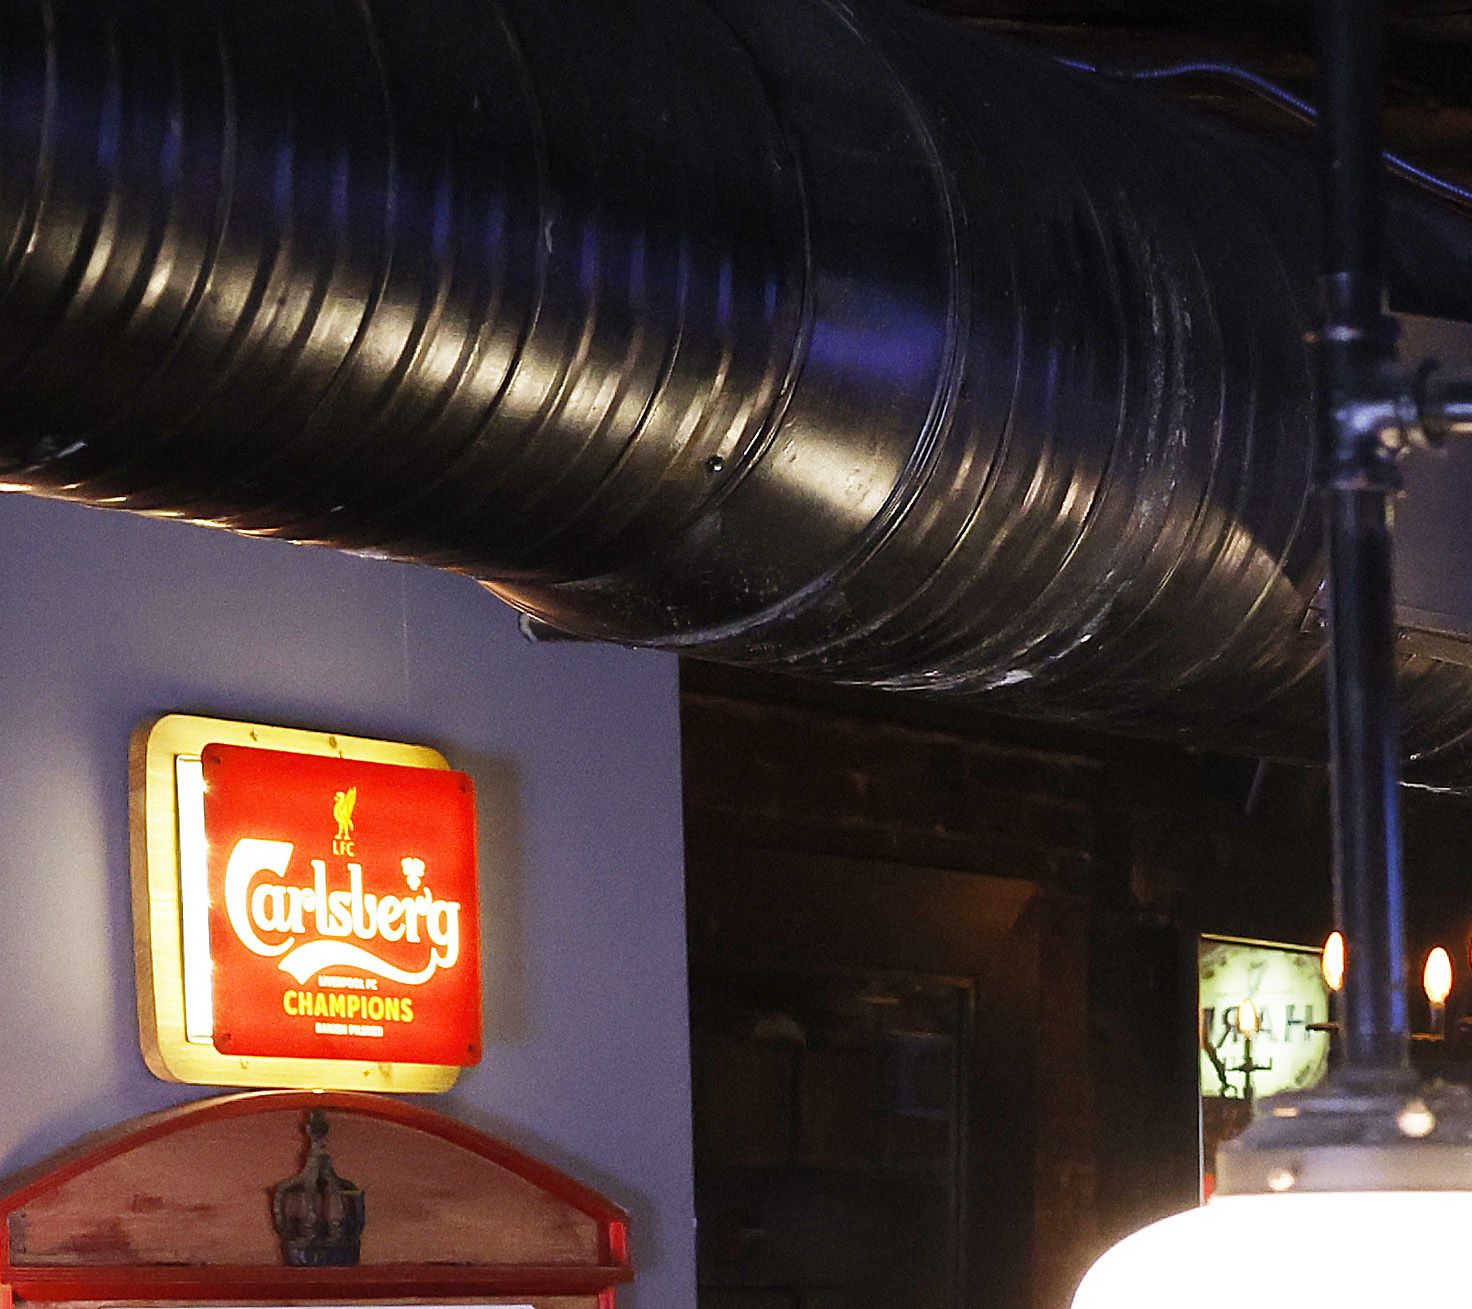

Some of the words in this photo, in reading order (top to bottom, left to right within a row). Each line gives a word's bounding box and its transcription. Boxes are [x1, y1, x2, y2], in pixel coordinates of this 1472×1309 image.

[333, 839, 355, 857] LFC
[225, 838, 461, 969] Carlsberg
[283, 989, 414, 1023] CHAMPIONS
